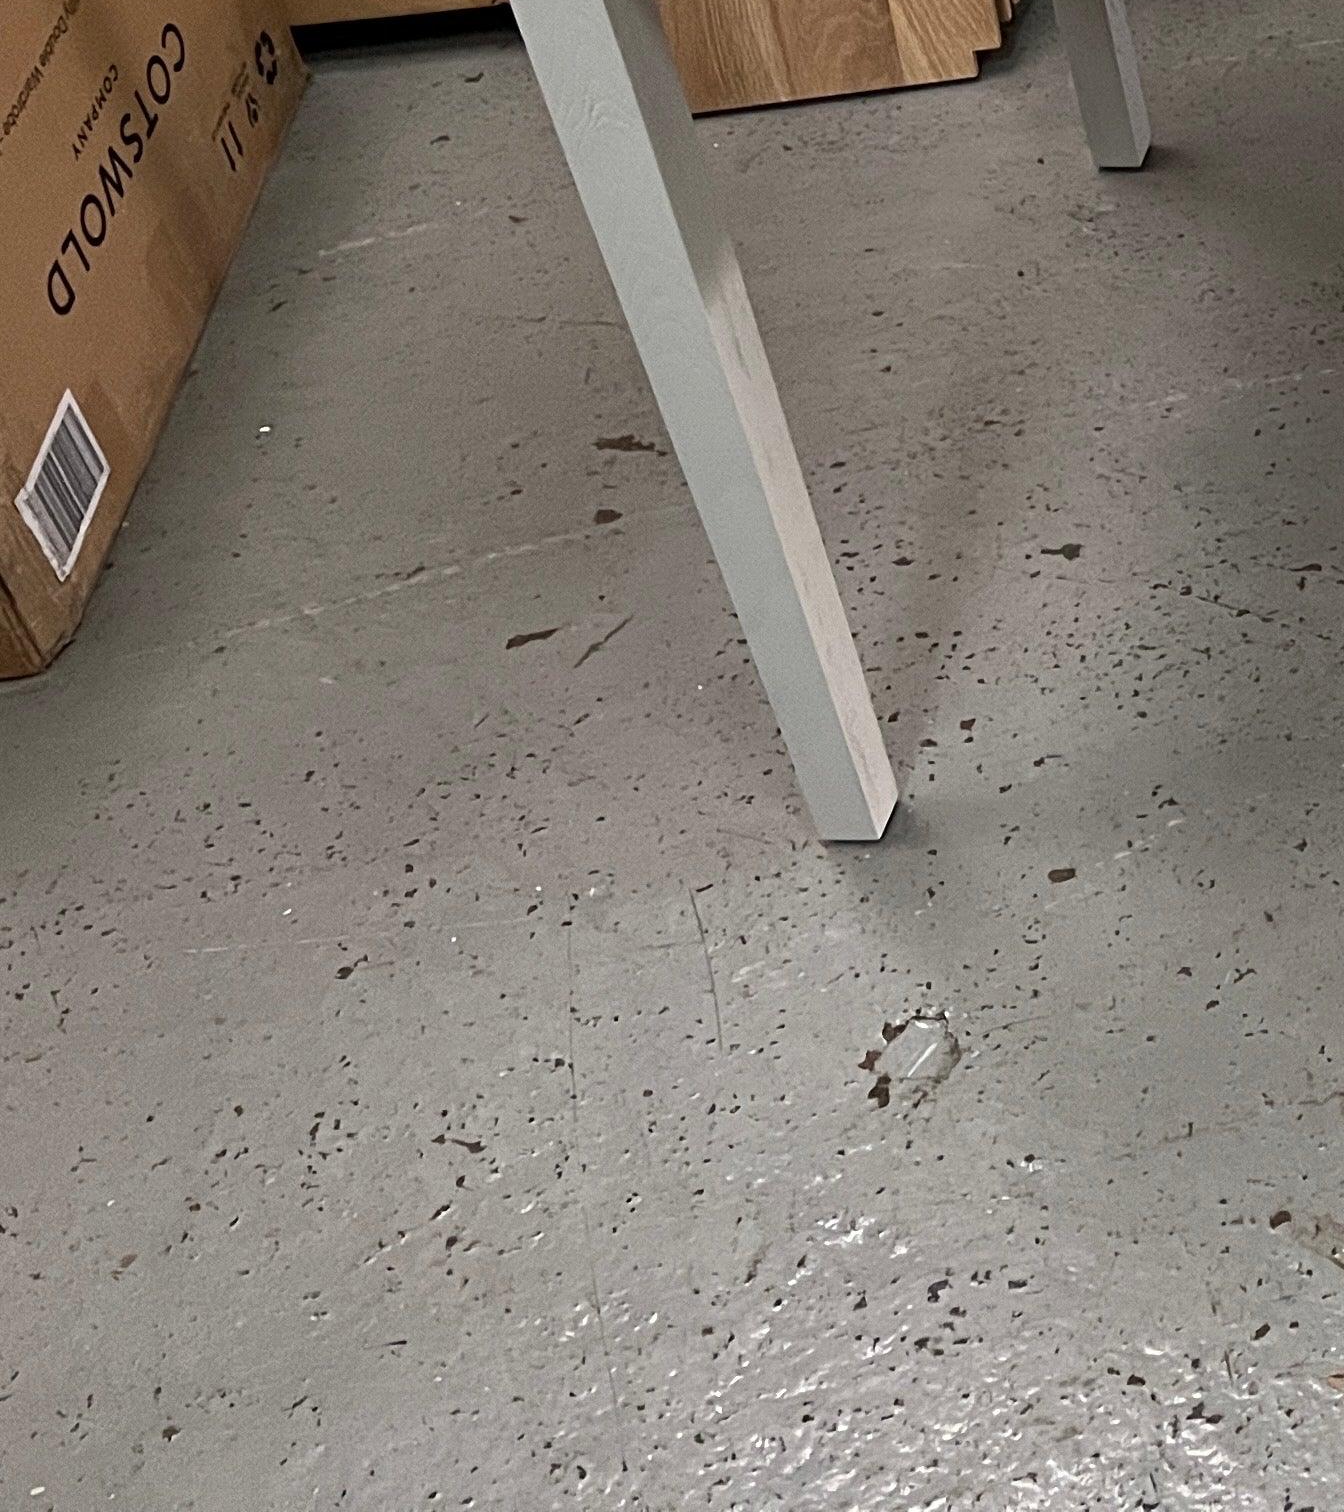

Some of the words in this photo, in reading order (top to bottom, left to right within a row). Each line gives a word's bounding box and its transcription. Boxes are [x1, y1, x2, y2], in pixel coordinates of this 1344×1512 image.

[3, 64, 44, 136] Wardrobe
[70, 63, 119, 161] COMPANY
[47, 23, 185, 315] COTSWOLD
